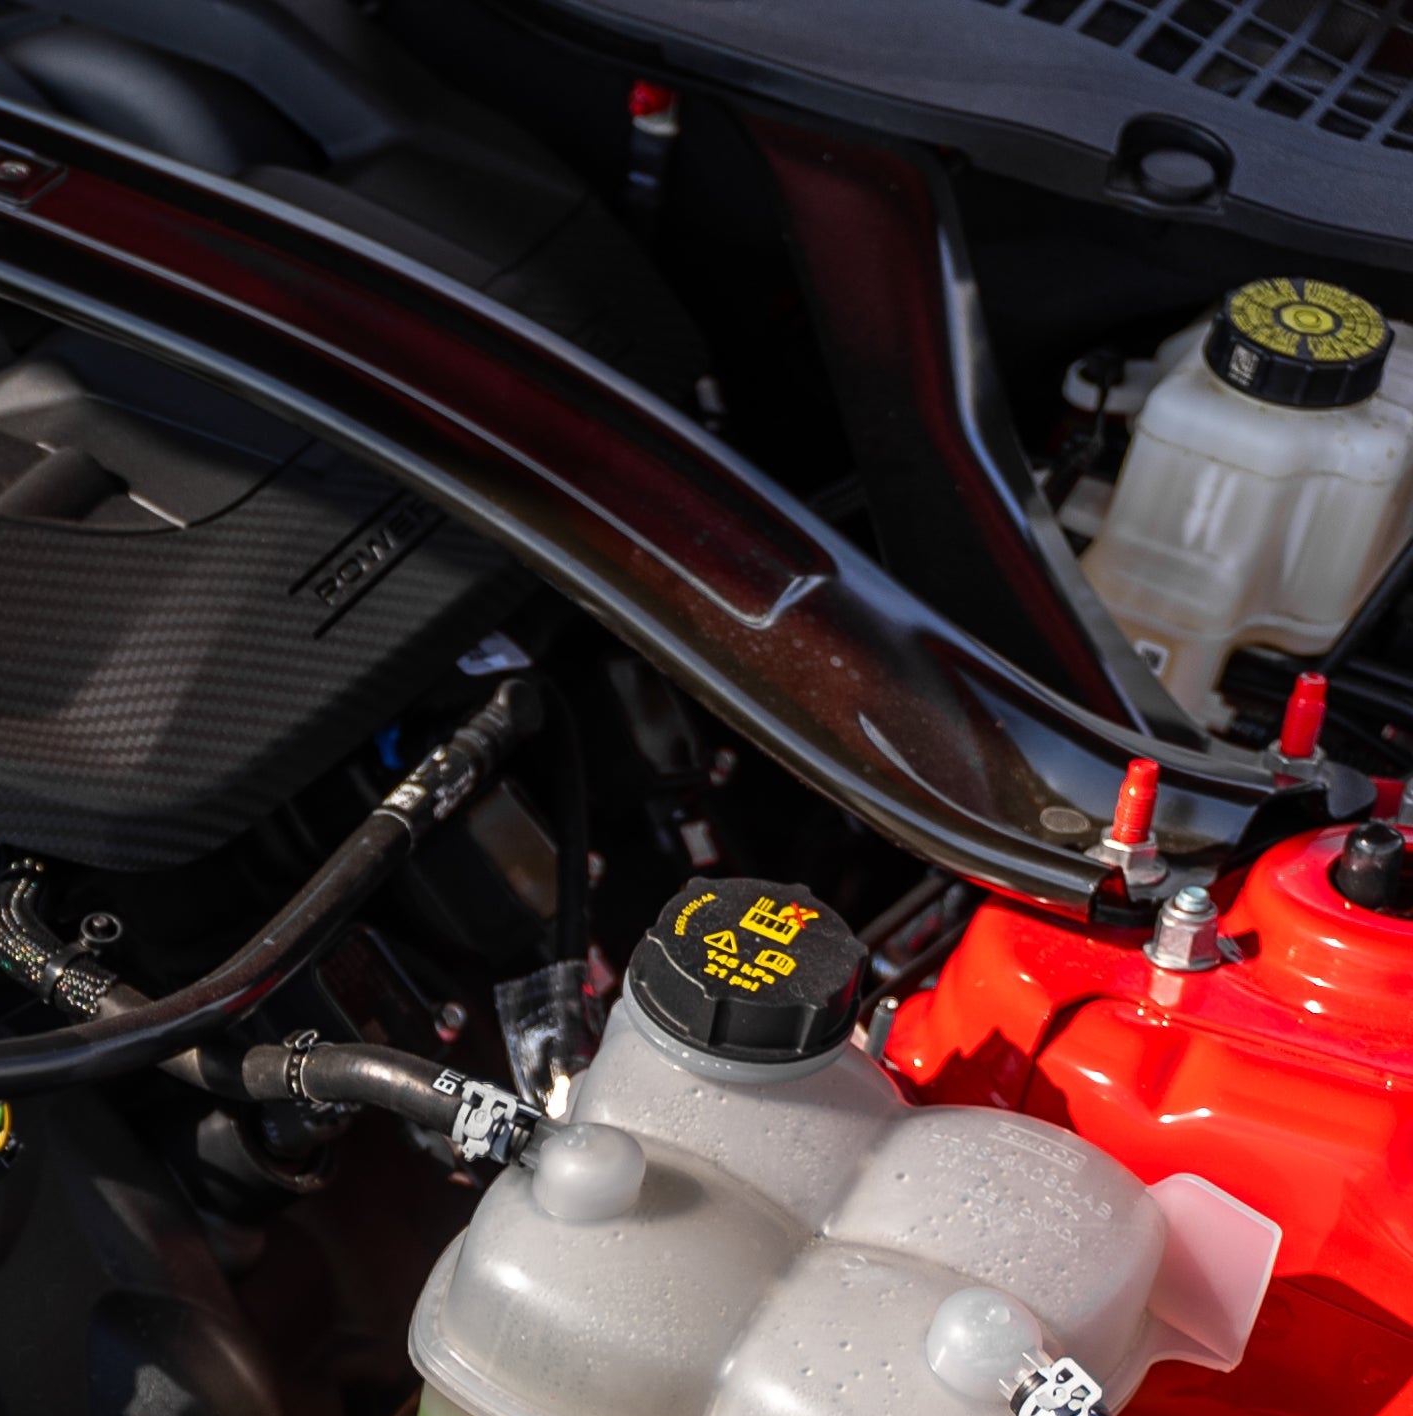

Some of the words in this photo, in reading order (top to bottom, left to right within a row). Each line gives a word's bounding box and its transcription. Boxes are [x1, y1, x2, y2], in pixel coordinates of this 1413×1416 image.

[703, 963, 729, 979] 21
[728, 974, 761, 993] psi
[706, 949, 740, 970] 145
[740, 962, 776, 985] kPa
